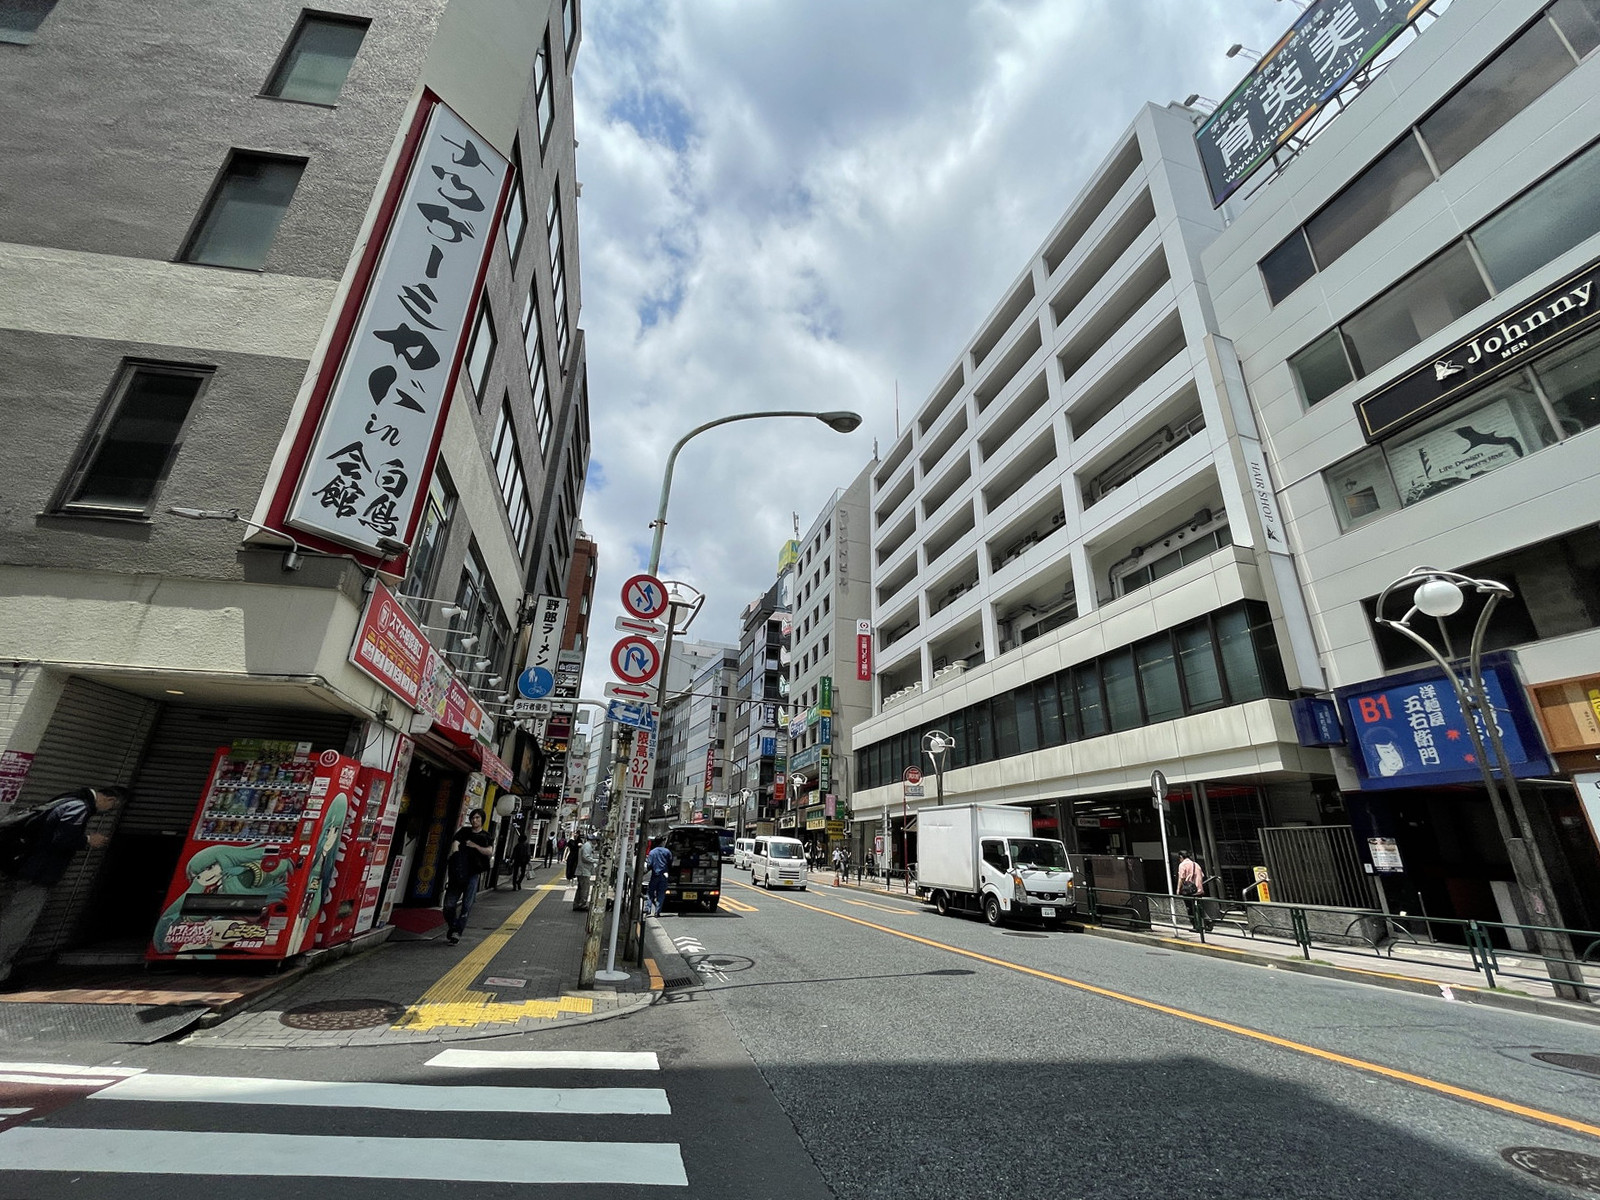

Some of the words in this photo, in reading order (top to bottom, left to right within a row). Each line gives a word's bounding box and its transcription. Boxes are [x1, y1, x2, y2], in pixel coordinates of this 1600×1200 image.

[1215, 0, 1390, 168] 育英美
[1243, 62, 1275, 99] 大学院
[1225, 47, 1364, 183] www.ikueiart.co.jp
[1467, 280, 1594, 364] Johnny
[1500, 339, 1529, 360] MEN
[364, 413, 403, 446] in
[1454, 452, 1484, 467] Design
[1250, 461, 1266, 489] HAIR
[1258, 490, 1275, 523] SHOP
[535, 599, 560, 667] 野郎ラーメン
[515, 702, 549, 713] 歩行者優先
[1358, 694, 1393, 723] B1
[1419, 684, 1446, 727] 洋麺屋
[1403, 695, 1441, 766] 五右衛門
[705, 750, 714, 786] ツルハドラッグ
